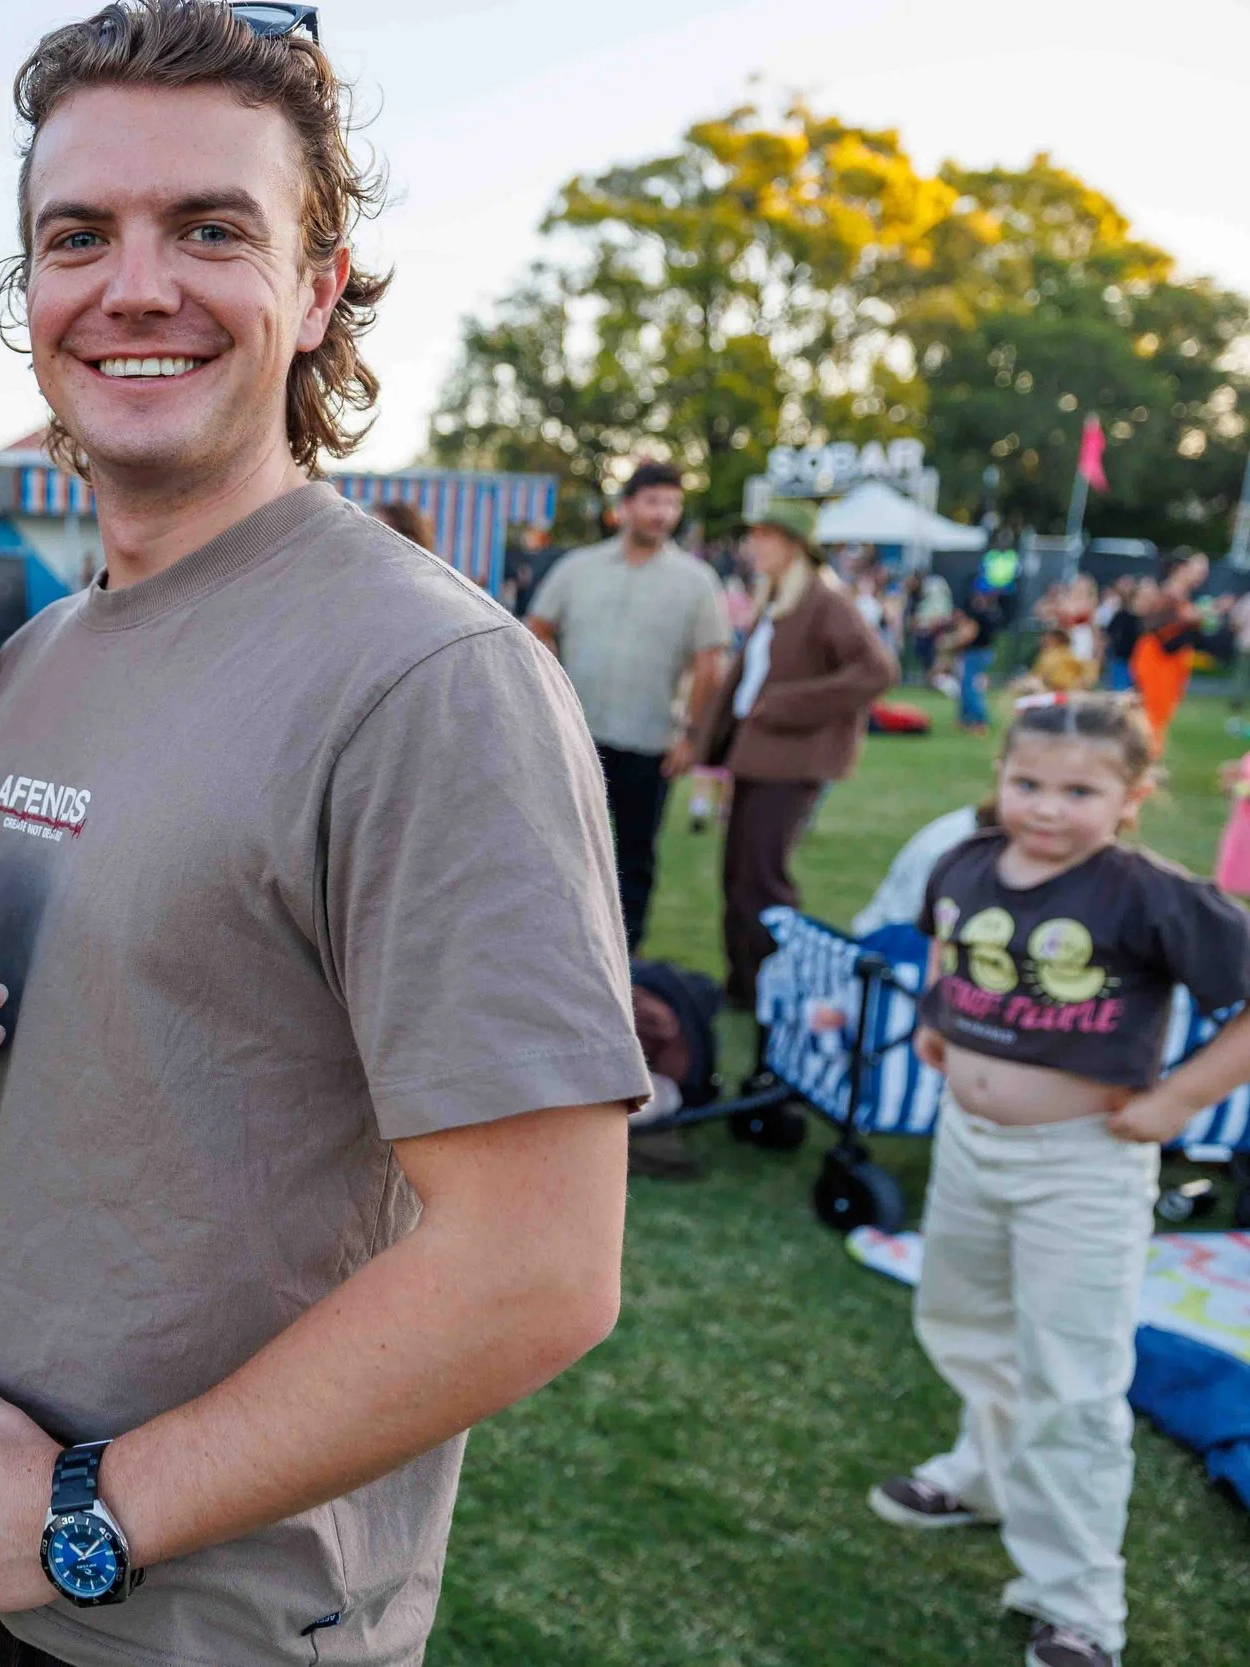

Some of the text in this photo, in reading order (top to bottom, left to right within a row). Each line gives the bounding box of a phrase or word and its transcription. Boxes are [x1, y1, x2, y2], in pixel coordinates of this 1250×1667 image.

[27, 823, 42, 836] NOT
[61, 1515, 75, 1526] 30
[98, 1526, 113, 1541] 40
